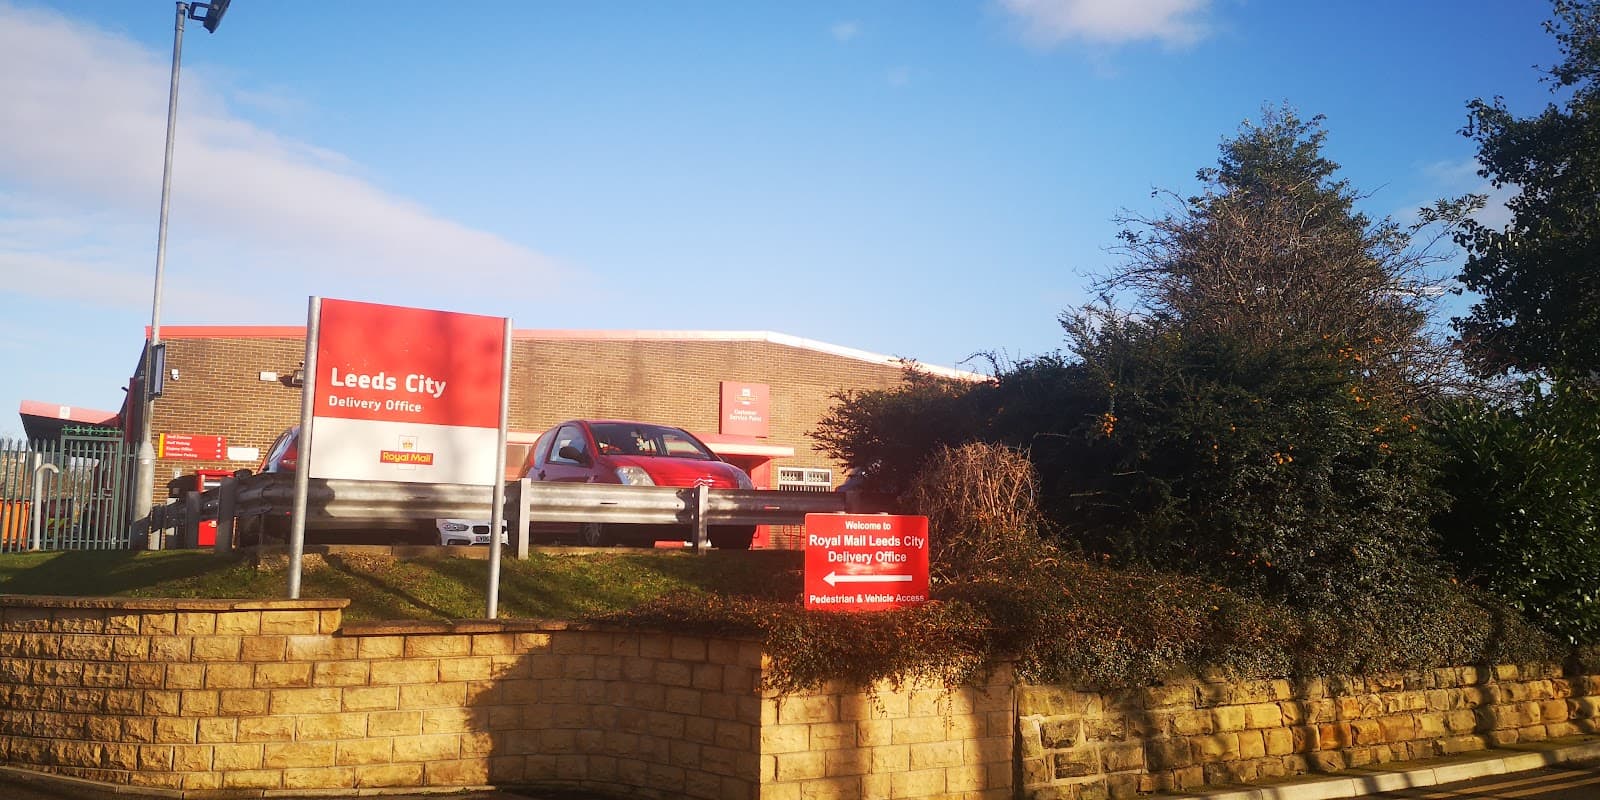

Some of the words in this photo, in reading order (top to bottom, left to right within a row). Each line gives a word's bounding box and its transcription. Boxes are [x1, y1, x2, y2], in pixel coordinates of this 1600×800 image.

[331, 367, 397, 391] Leeds
[405, 374, 447, 399] City
[328, 395, 381, 412] Delivery
[385, 399, 423, 412] Office
[383, 452, 409, 463] Royal
[411, 453, 431, 462] Mail
[845, 521, 881, 530] Welcome
[883, 522, 891, 530] to
[809, 534, 841, 549] Royal
[843, 535, 866, 546] Mail
[869, 535, 901, 547] Leeds
[903, 535, 924, 549] City
[828, 551, 873, 565] Delivery
[875, 551, 907, 562] Office
[809, 594, 855, 604] Pedestrian
[856, 594, 863, 603] &
[865, 594, 894, 602] Vehicle
[895, 594, 925, 602] Access
